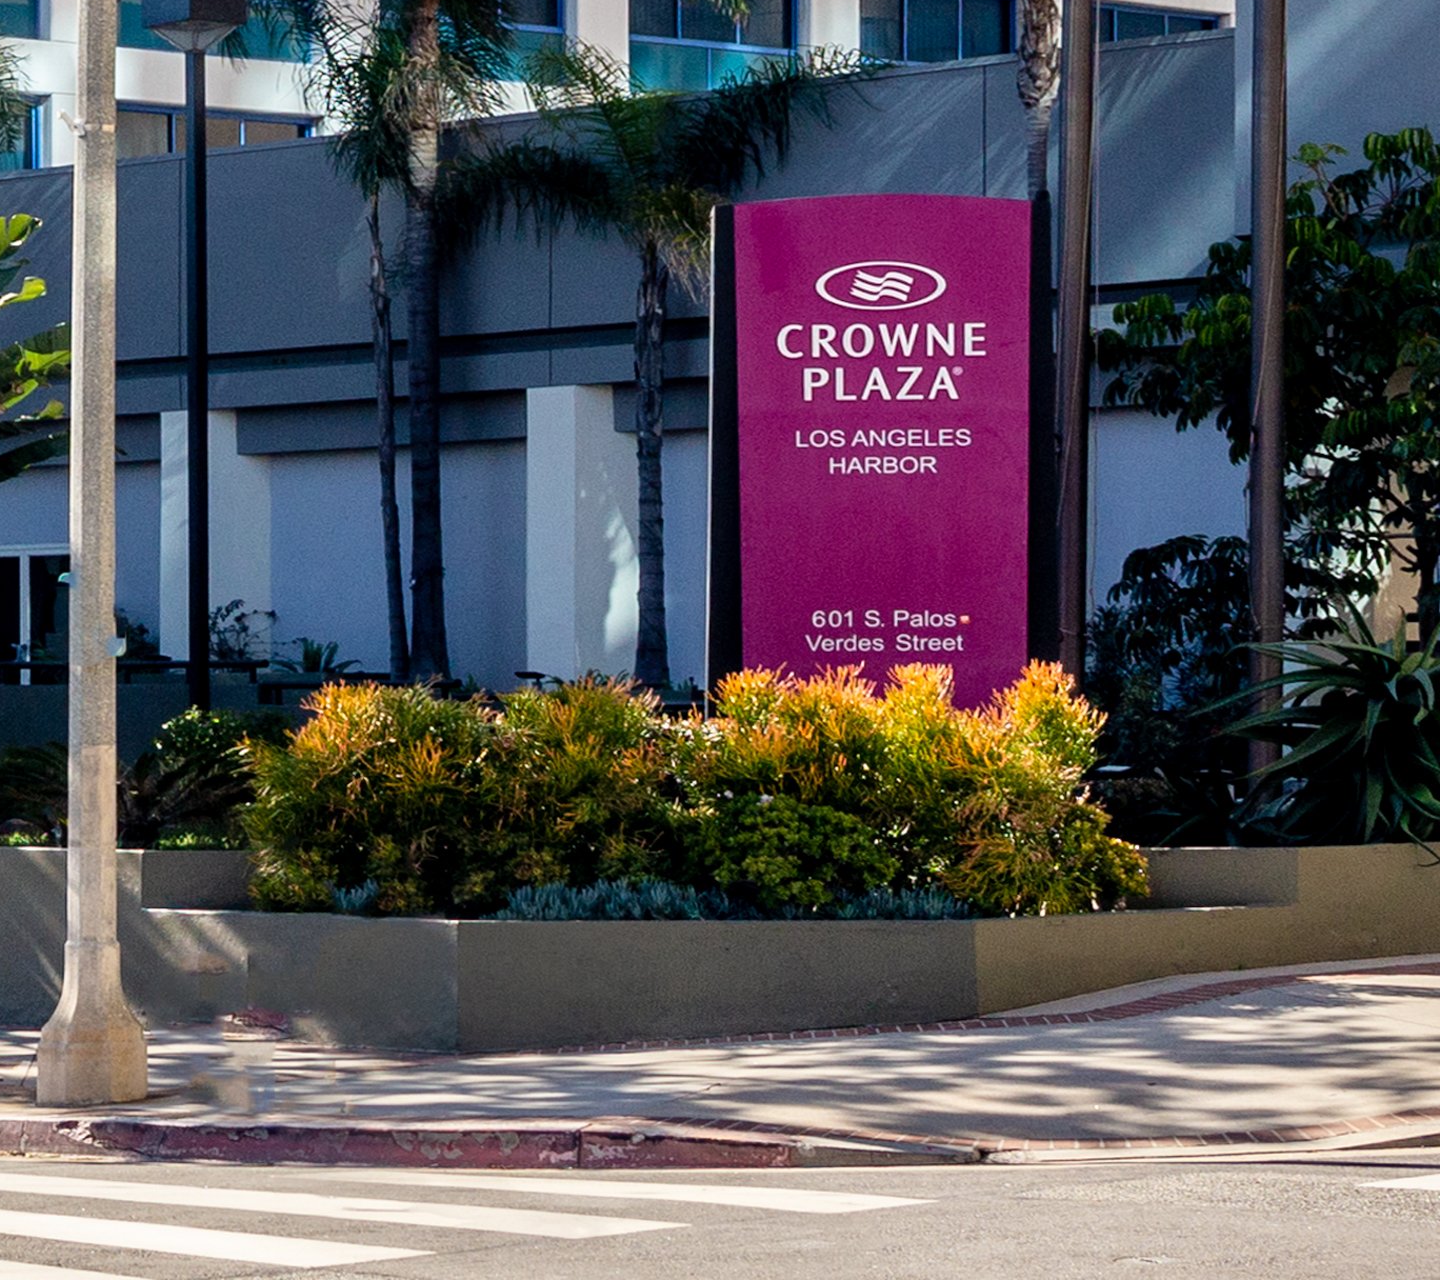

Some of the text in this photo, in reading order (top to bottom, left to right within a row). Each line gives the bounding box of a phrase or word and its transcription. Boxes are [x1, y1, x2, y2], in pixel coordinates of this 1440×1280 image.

[776, 322, 987, 359] CROWNE
[795, 429, 972, 448] LOS ANGELES
[828, 456, 938, 474] HARBOR
[811, 610, 957, 628] 601 S. Palos
[804, 633, 964, 652] Verdes Street
